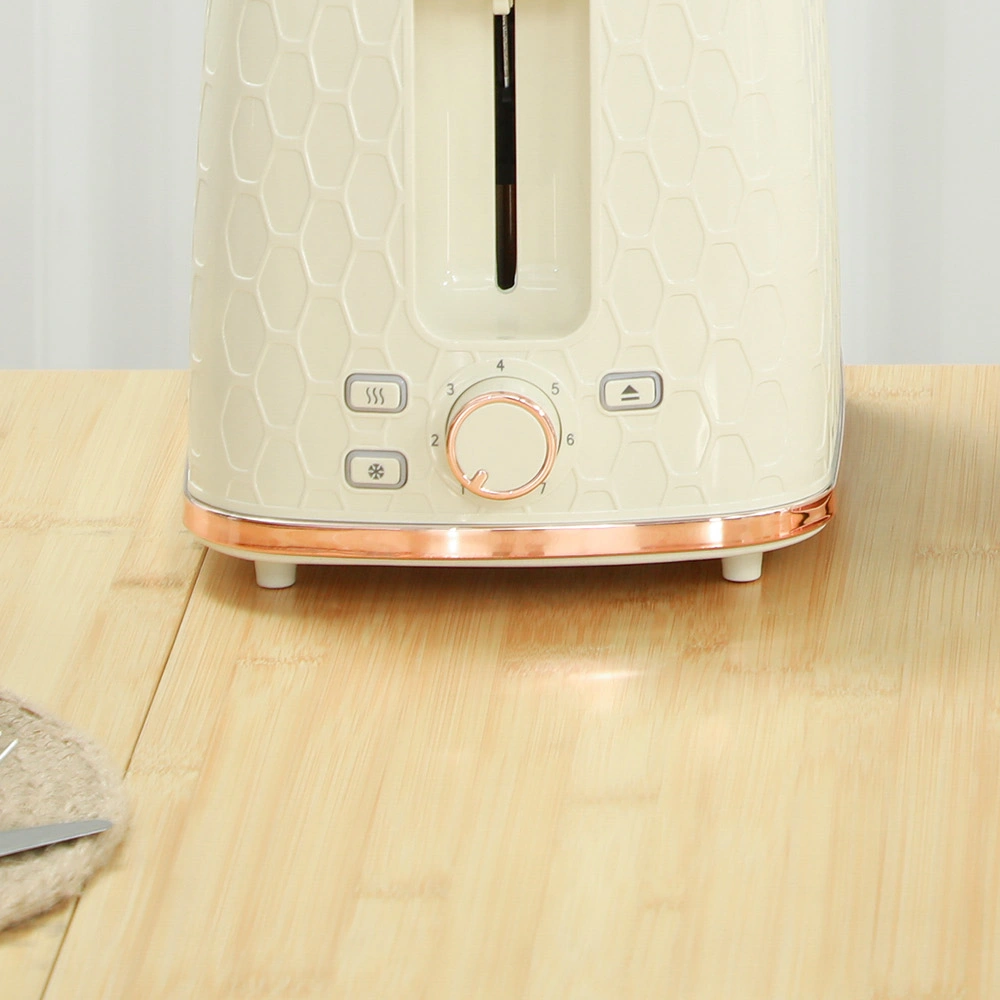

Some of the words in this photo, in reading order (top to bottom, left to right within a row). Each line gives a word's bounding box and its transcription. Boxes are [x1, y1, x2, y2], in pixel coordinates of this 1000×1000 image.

[496, 359, 505, 371] 4
[446, 383, 455, 396] 3
[551, 383, 560, 395] 5
[431, 434, 439, 447] 2
[566, 433, 575, 446] 6
[541, 482, 547, 495] 7
